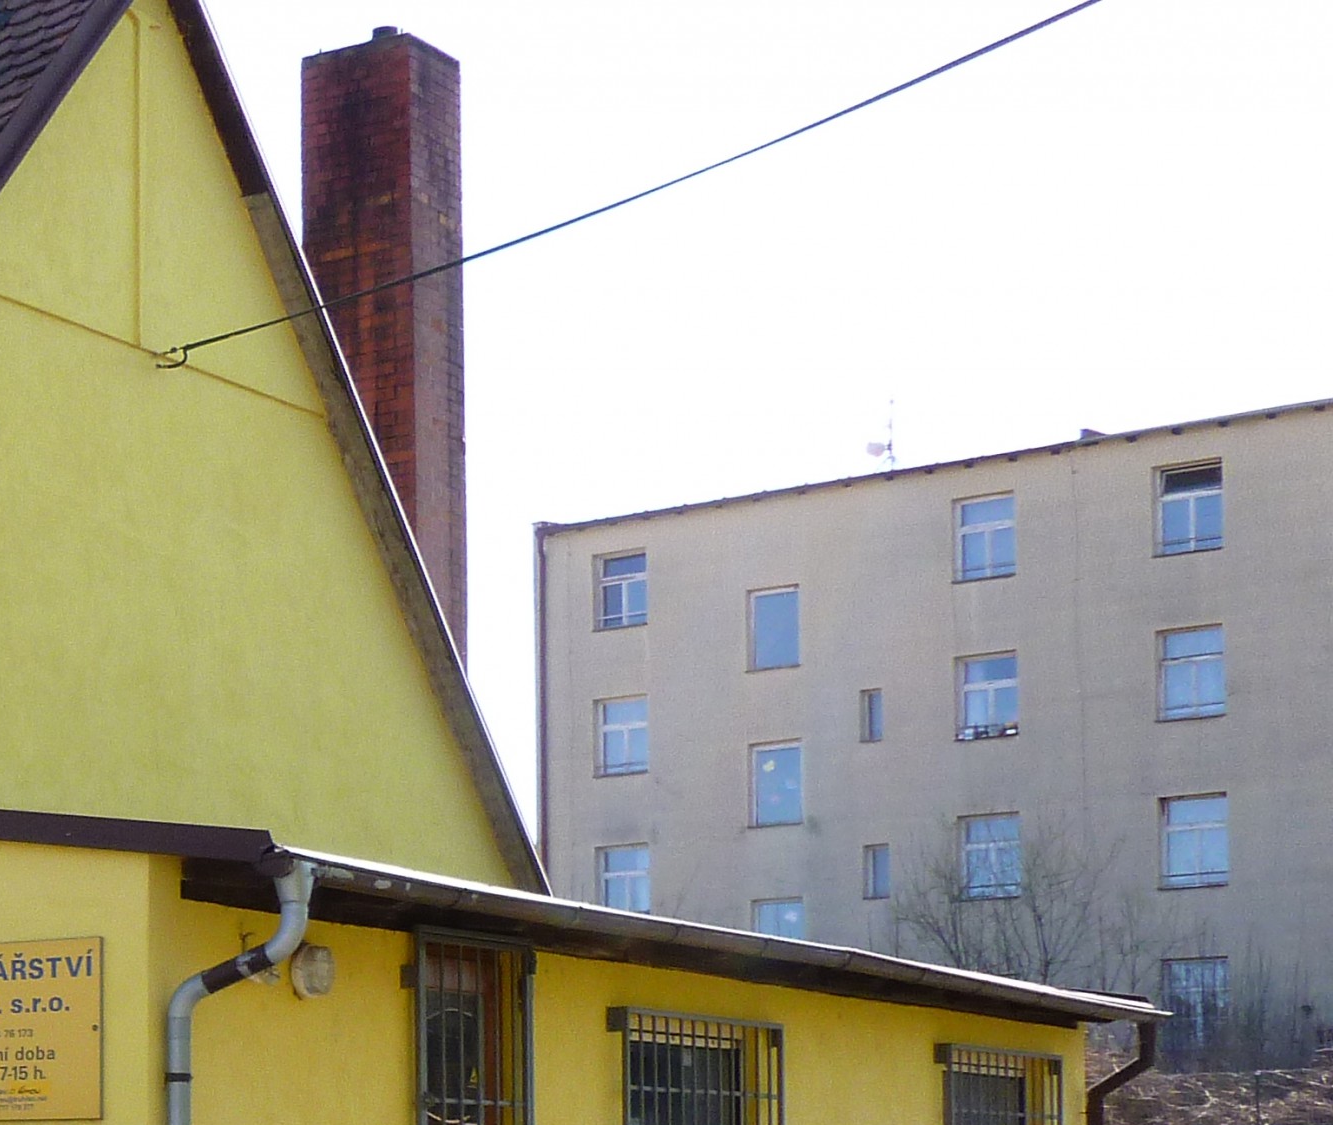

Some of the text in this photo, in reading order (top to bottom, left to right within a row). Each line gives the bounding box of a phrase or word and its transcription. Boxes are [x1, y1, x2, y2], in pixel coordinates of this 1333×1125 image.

[10, 996, 71, 1014] s.r.o.
[15, 1046, 56, 1061] doba
[0, 1065, 28, 1081] 7-15
[33, 1065, 46, 1080] h.
